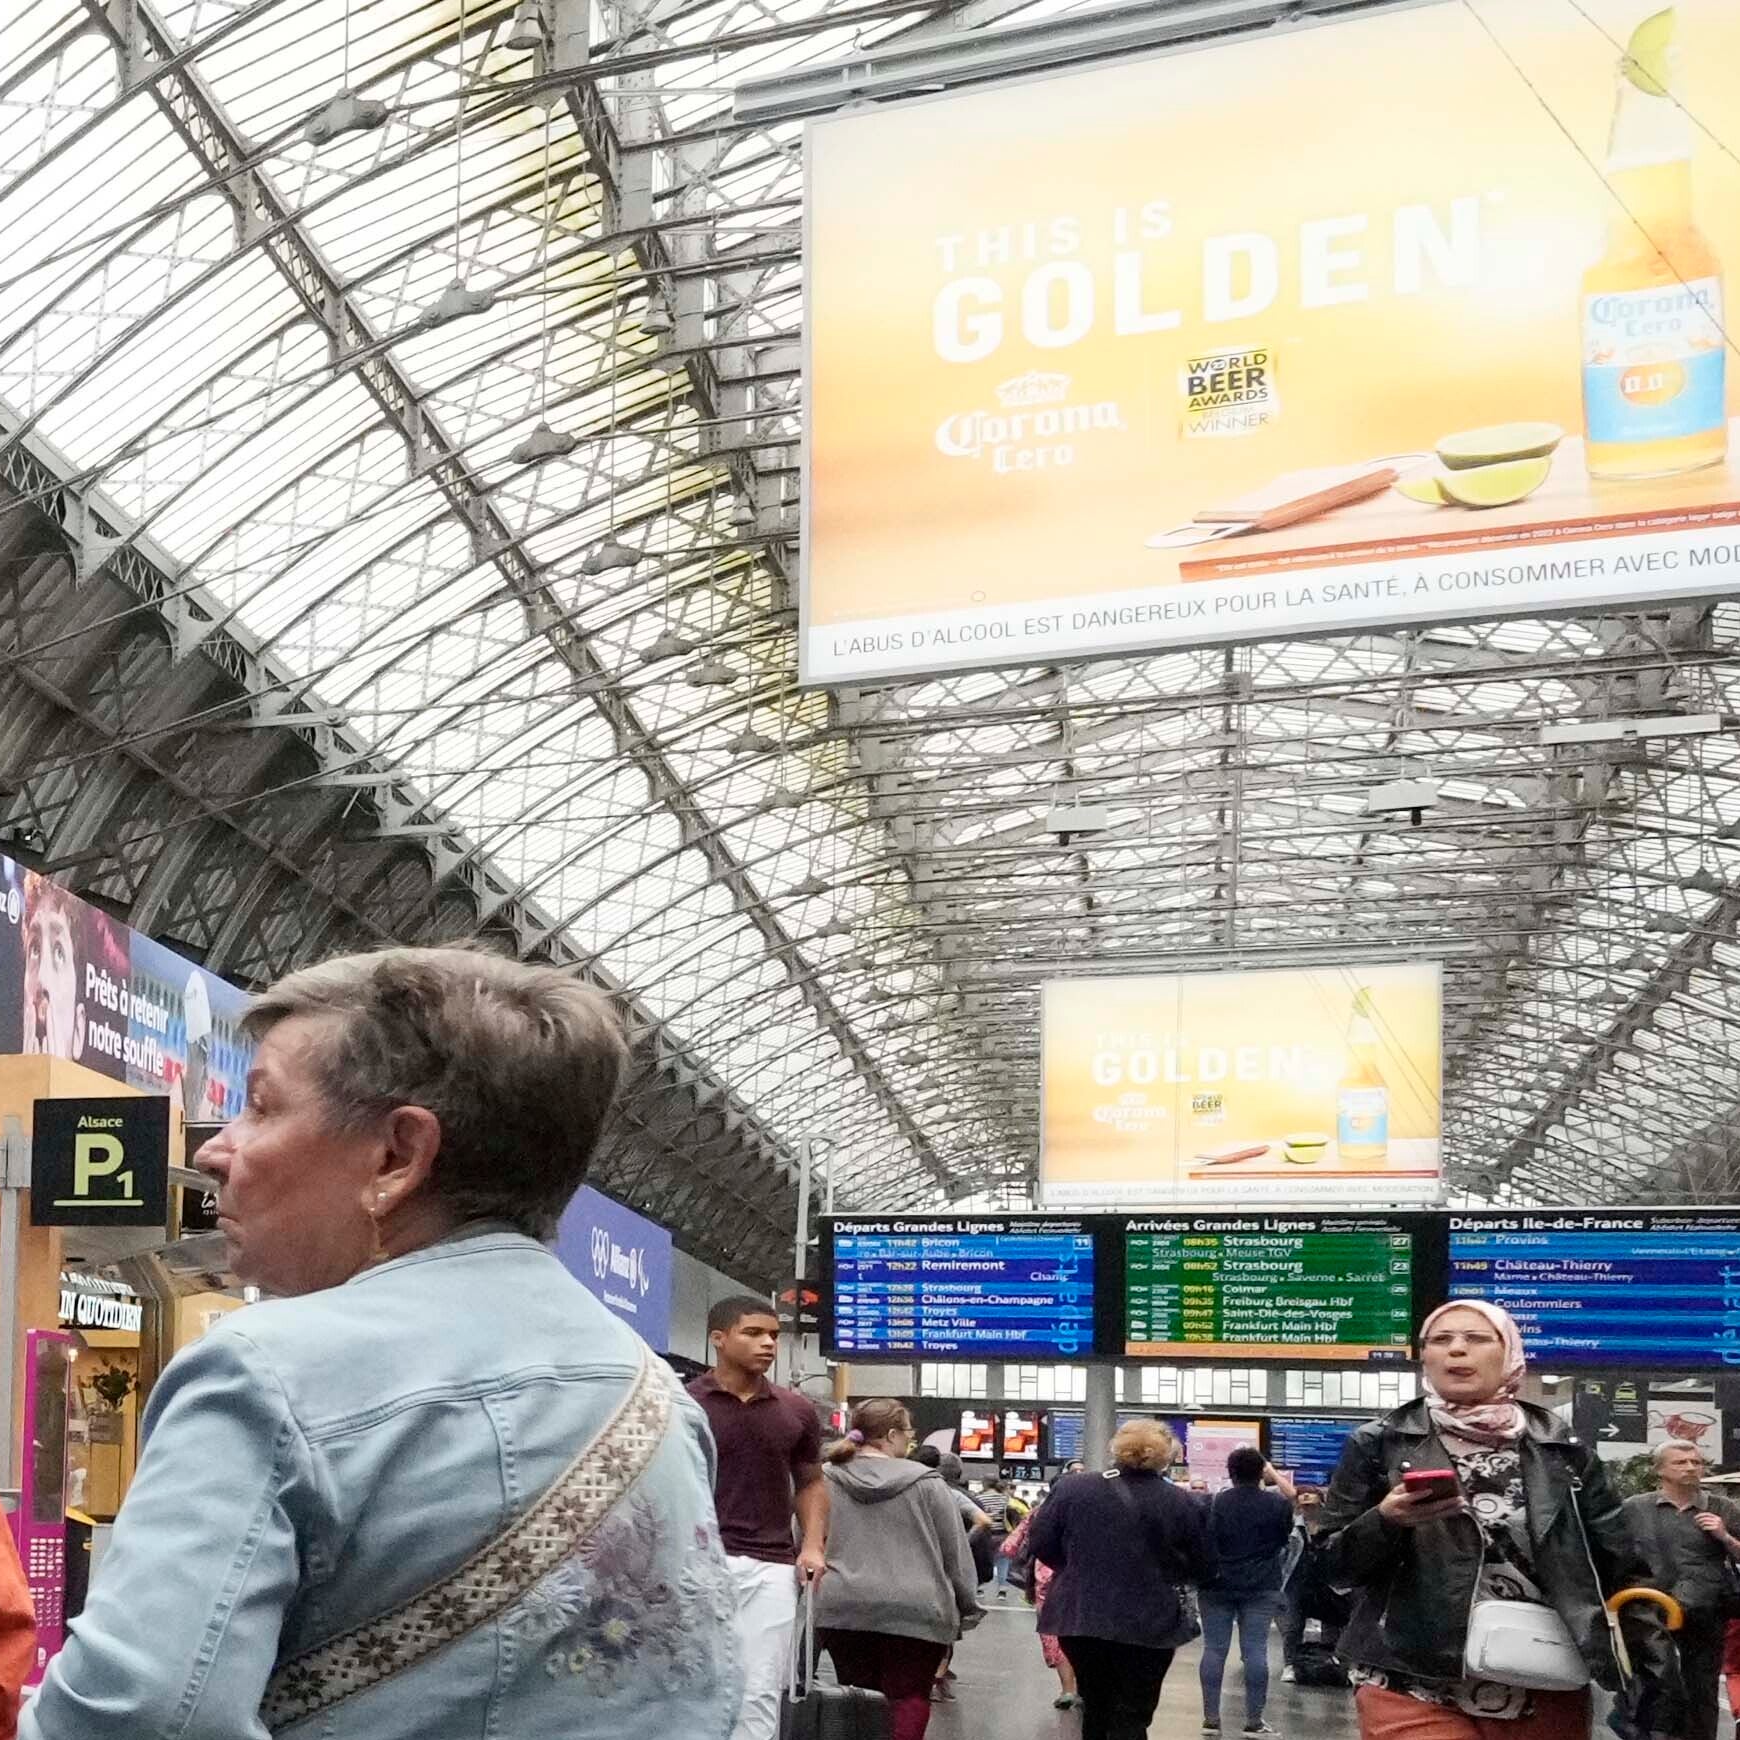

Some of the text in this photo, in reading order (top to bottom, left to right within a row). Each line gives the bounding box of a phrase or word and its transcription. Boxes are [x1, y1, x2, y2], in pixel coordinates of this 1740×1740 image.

[935, 200, 1174, 272] THIS IS
[932, 198, 1481, 364] GOLDEN
[1188, 353, 1268, 375] WORLD
[1188, 367, 1267, 396] BEER
[1189, 388, 1268, 408] AWARDS
[1189, 412, 1269, 433] WINNER
[935, 402, 1125, 458] Corona
[833, 633, 904, 657] L'ABUS
[912, 620, 1016, 648] D'ALCOOL
[1024, 615, 1063, 636] EST
[1072, 599, 1207, 632] DANGEREUX
[1215, 591, 1277, 615] POUR
[1286, 585, 1315, 605] LA
[1322, 577, 1408, 603] SANTÉ,
[1413, 570, 1430, 594] À
[1439, 557, 1606, 592] CONSOMMER
[1613, 550, 1680, 576] AVEC
[86, 963, 169, 1034] Prêts à retenir
[88, 1020, 165, 1078] notre souffle
[1091, 1043, 1308, 1087] GOLDEN
[1192, 1099, 1222, 1110] BEER
[77, 1115, 124, 1129] Alsace
[74, 1133, 134, 1198] P1
[833, 1221, 890, 1235] Départs
[893, 1221, 953, 1233] Grandes
[957, 1221, 1005, 1234] Lignes
[1125, 1219, 1190, 1231] Arrivées
[1193, 1219, 1260, 1231] Grandes
[1263, 1219, 1316, 1232] Lignes
[1449, 1217, 1518, 1231] Départs
[1522, 1217, 1644, 1230] Ile-de-France
[922, 1237, 960, 1247] Bricon
[1223, 1236, 1304, 1249] Strasbourg
[1392, 1238, 1408, 1246] 27
[1495, 1235, 1549, 1245] Provins
[1152, 1248, 1292, 1259] Strasbourg Meuse TGV
[922, 1260, 1006, 1271] Remiremont
[1223, 1260, 1304, 1274] Strasbourg
[1495, 1259, 1613, 1273] Château-Thierry
[1212, 1272, 1336, 1283] Strasbourg Saverne
[1539, 1272, 1634, 1283] Château-Thierry
[922, 1283, 982, 1294] Strasbourg
[1222, 1284, 1268, 1294] Colmar
[1495, 1286, 1538, 1296] Meaux
[922, 1294, 1054, 1306] Châlons-en-Champagne
[1222, 1296, 1274, 1308] Freiburg
[1275, 1296, 1327, 1308] Breisgau
[1329, 1296, 1354, 1307] Hbf
[1495, 1299, 1583, 1310] Coulommiers
[58, 1289, 143, 1332] IN QUOTIDIEN
[922, 1307, 958, 1317] Troyes
[1223, 1308, 1353, 1321] Saint-Dié-des-Vosges
[922, 1318, 977, 1328] Metz Ville
[1223, 1320, 1337, 1331] Frankfurt Main Hbf
[922, 1329, 974, 1339] Frankfurt
[976, 1330, 1004, 1339] Main
[1223, 1332, 1338, 1343] Frankfurt Main Hbf
[922, 1341, 958, 1351] Troyes
[1524, 1337, 1600, 1349] eau-Thierry
